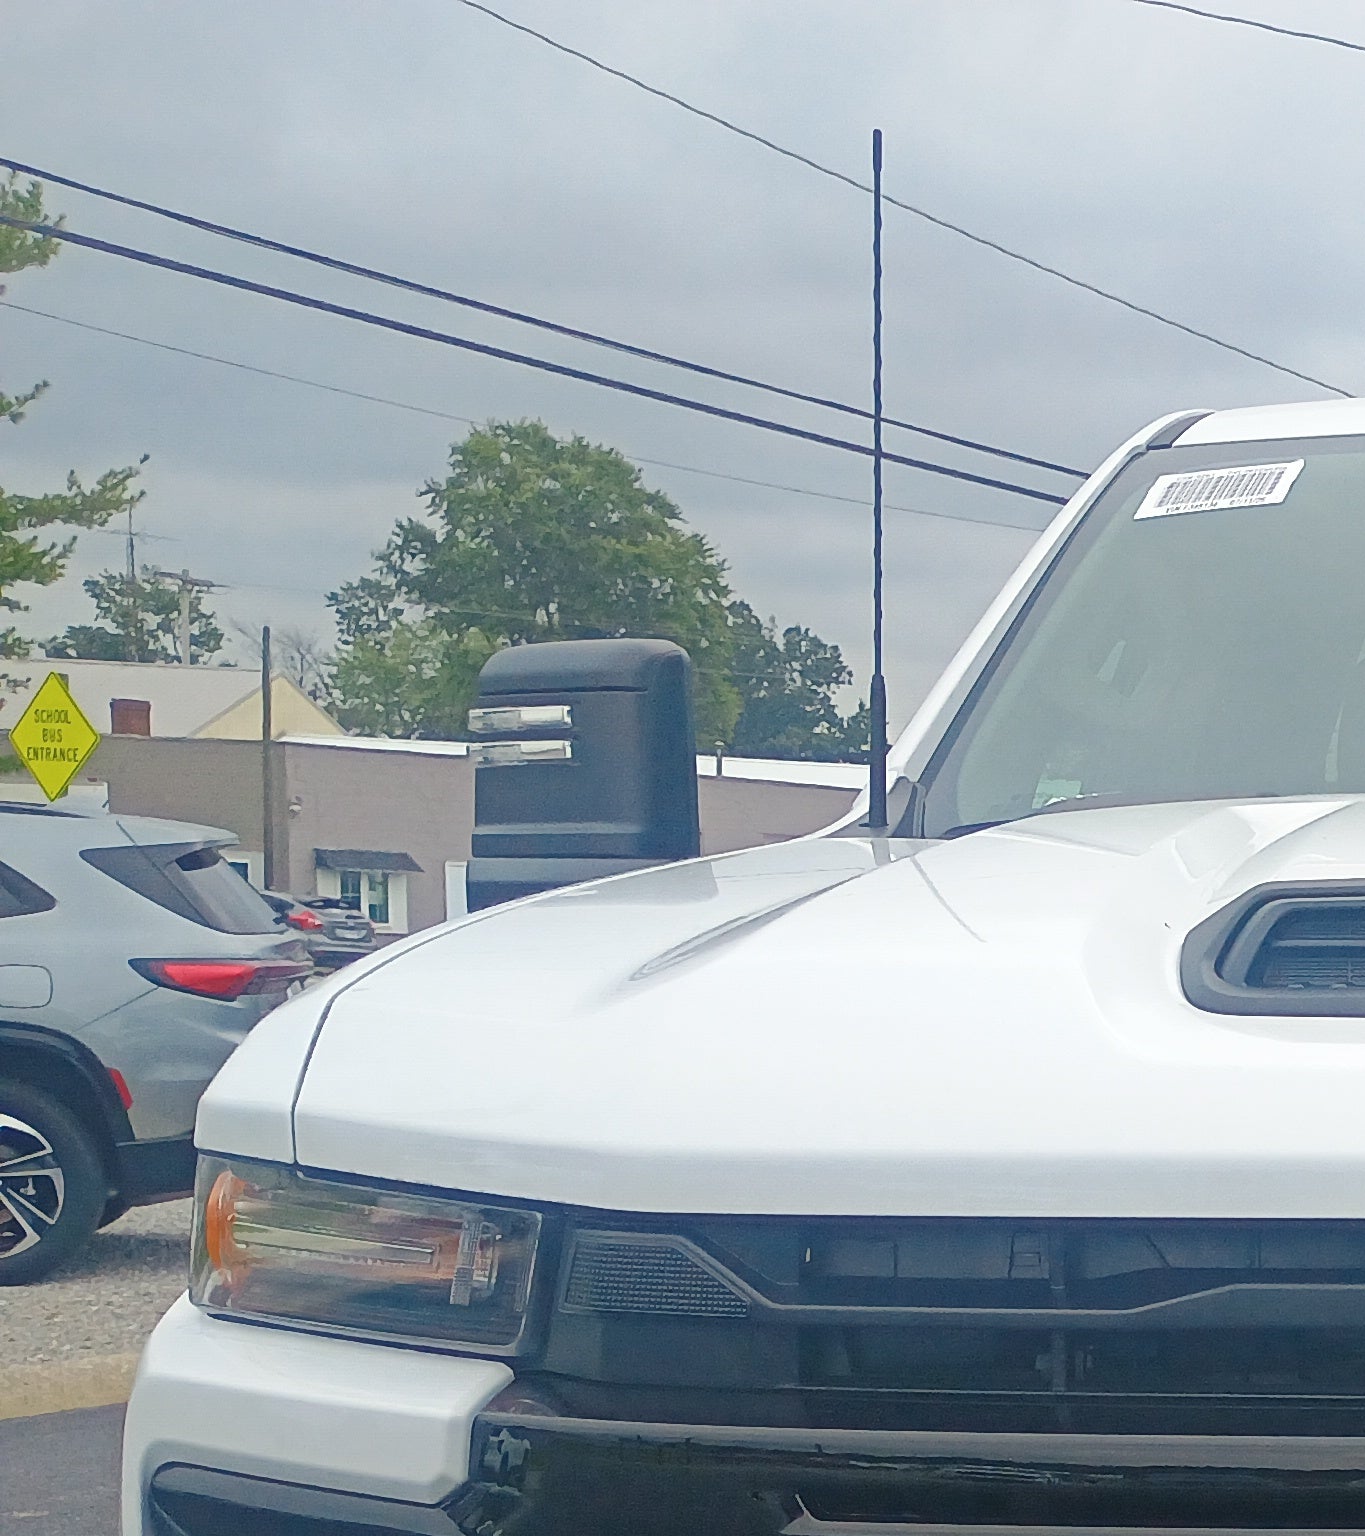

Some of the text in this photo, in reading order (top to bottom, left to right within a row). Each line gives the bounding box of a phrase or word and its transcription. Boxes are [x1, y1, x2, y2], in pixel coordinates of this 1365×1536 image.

[34, 709, 71, 724] SCHOOL
[42, 728, 62, 742] BUS
[27, 747, 79, 762] ENTRANCE
